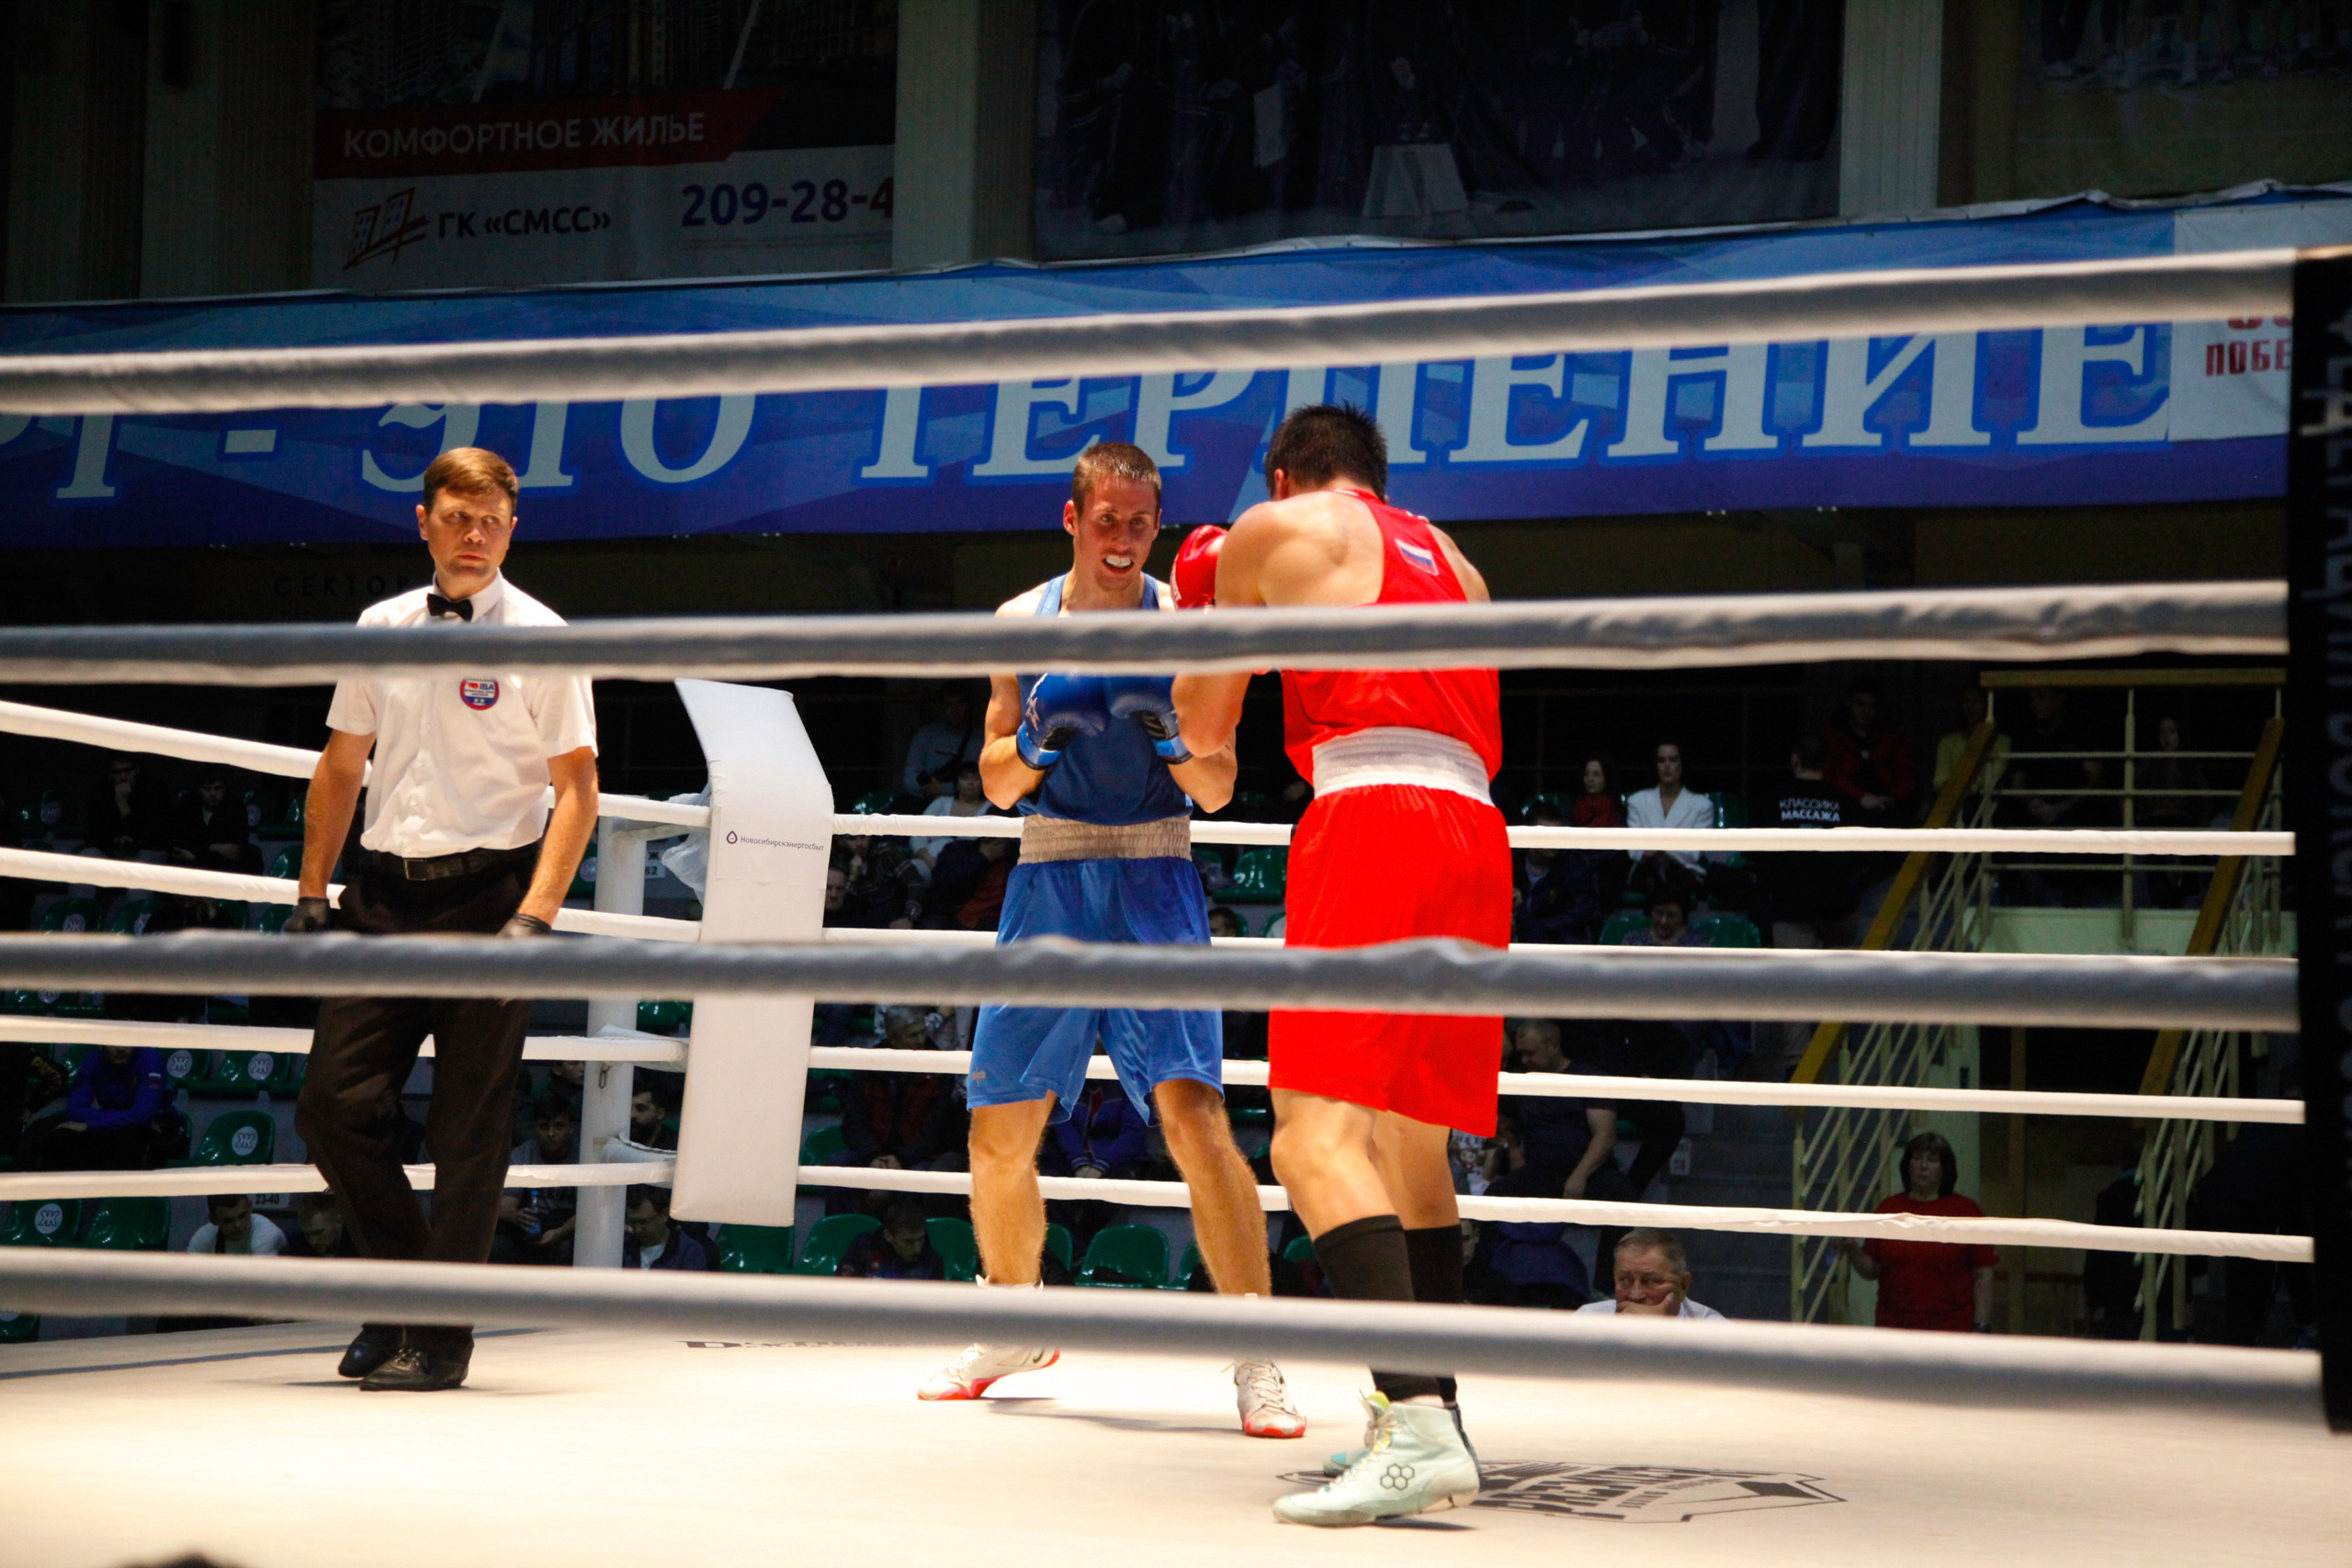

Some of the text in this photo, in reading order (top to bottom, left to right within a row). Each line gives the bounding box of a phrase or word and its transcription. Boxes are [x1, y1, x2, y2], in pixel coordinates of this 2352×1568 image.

[343, 111, 705, 159] КОМФОРТНОЕ ЖИЛЬЕ
[438, 206, 611, 238] ГК «СМСС»
[275, 575, 410, 597] СЕКТОР
[1779, 797, 1840, 810] КЛАССИКА
[1781, 809, 1840, 821] МАССАЖА
[741, 836, 824, 851] Новосибирскэнергосбыт
